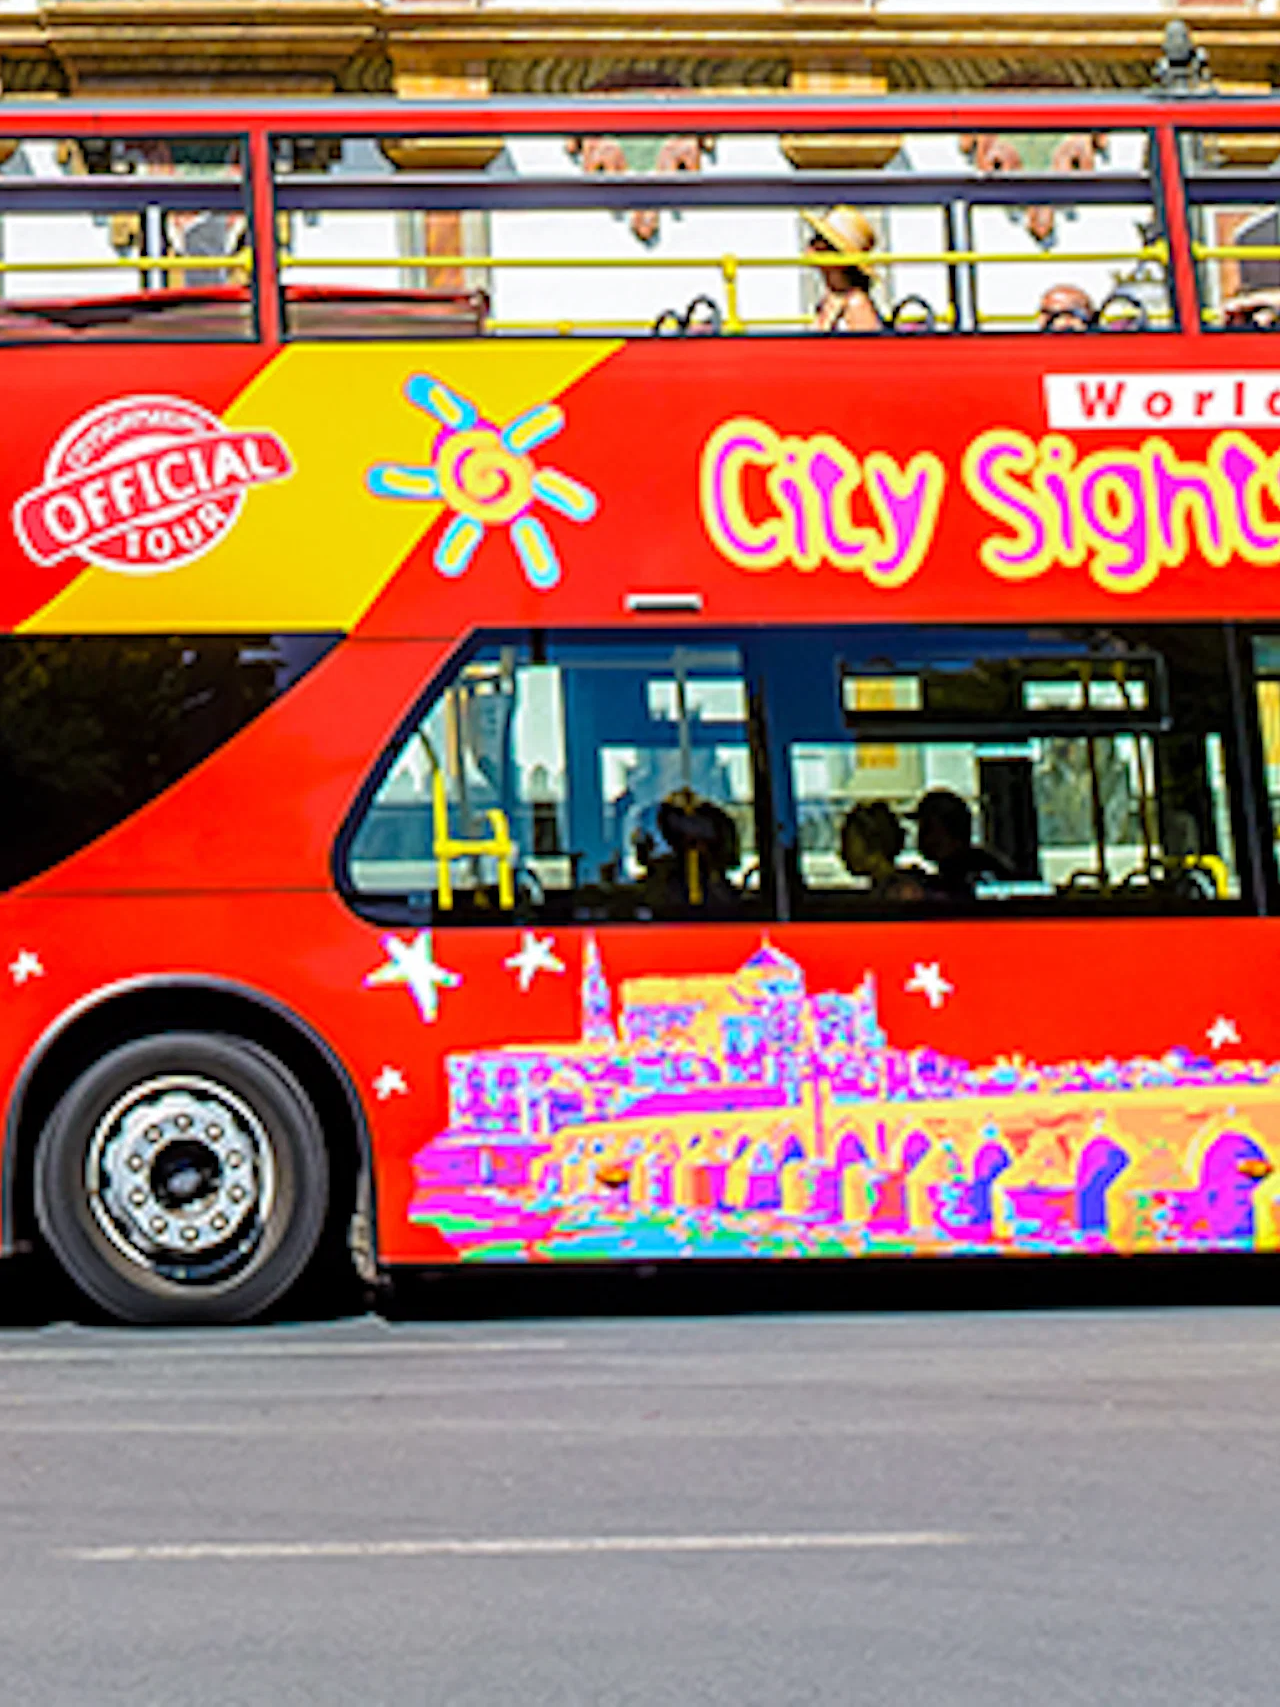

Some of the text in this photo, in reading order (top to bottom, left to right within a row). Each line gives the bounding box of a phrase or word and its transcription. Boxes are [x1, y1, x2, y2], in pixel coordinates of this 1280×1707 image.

[43, 439, 278, 543] OFFICIAL
[125, 501, 226, 559] TOUR
[700, 416, 1280, 594] City Sight
